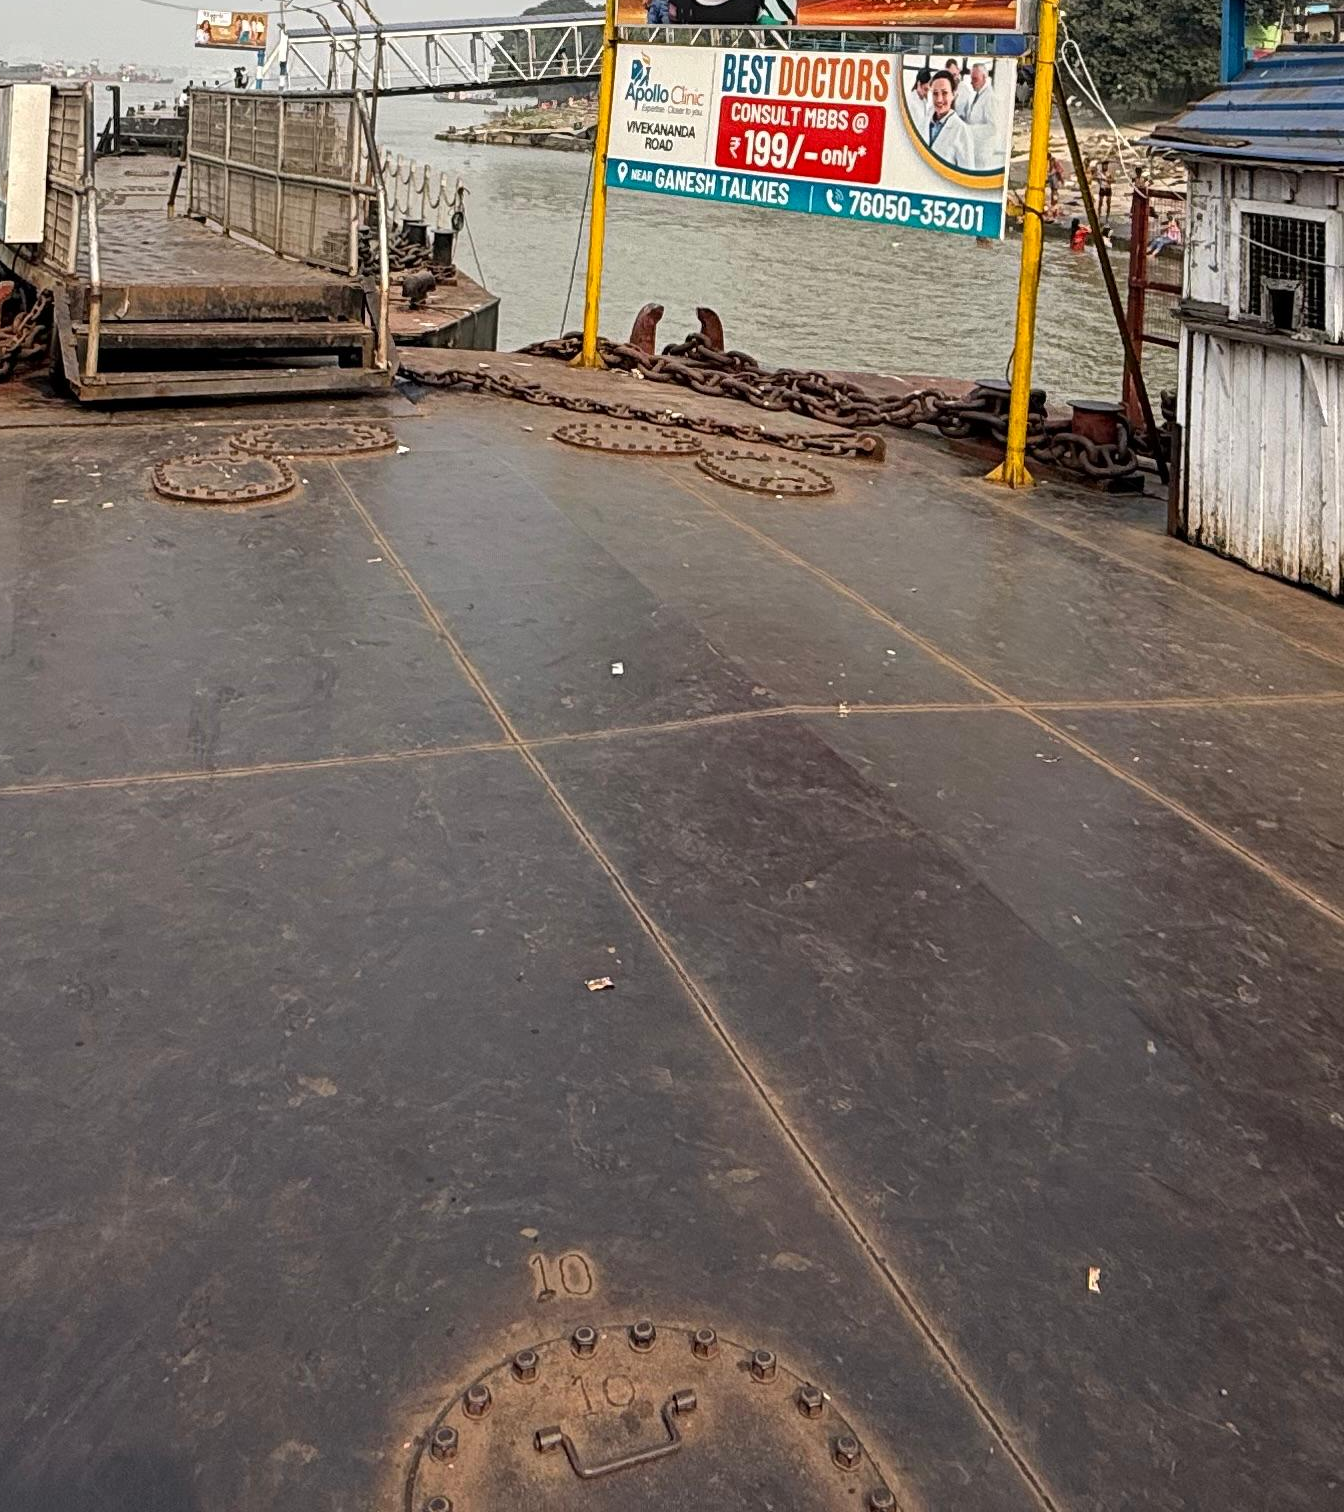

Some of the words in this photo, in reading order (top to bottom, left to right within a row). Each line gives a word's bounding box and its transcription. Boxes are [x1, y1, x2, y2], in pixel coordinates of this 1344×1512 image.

[721, 53, 777, 95] BEST
[778, 56, 891, 102] DOCTORS
[624, 82, 669, 111] Apollo
[671, 85, 705, 106] Clinic
[626, 120, 696, 139] VIVEKANANDA
[731, 102, 802, 127] CONSULT
[803, 107, 849, 131] MBBS
[852, 112, 870, 134] @
[644, 137, 674, 151] ROAD
[630, 168, 653, 182] NEAR
[655, 168, 717, 196] GANESH
[719, 175, 790, 205] TALKIES
[848, 190, 985, 232] 76050-35201
[532, 1254, 593, 1303] 10
[571, 1373, 636, 1416] 10
